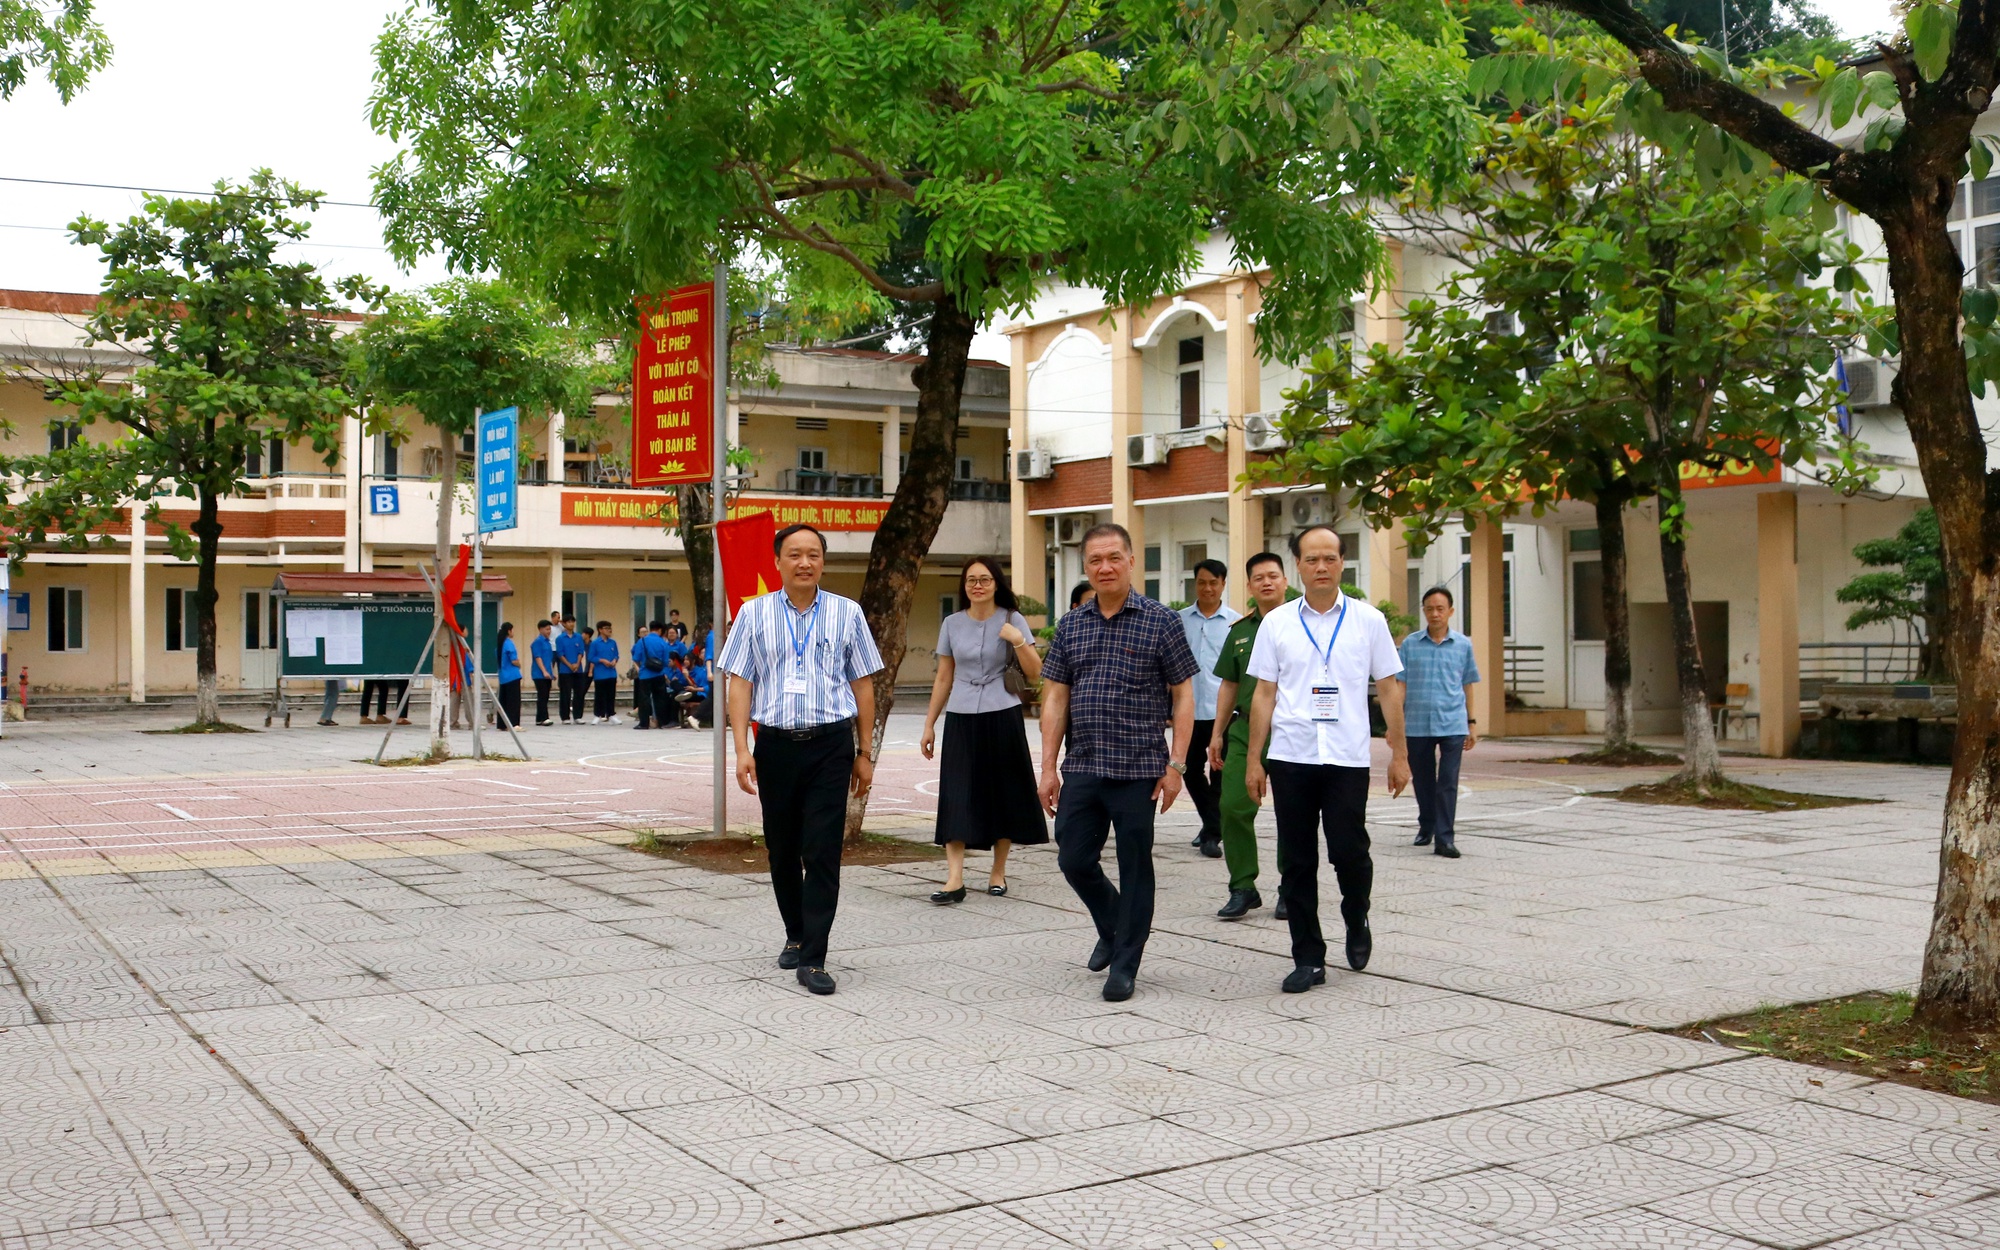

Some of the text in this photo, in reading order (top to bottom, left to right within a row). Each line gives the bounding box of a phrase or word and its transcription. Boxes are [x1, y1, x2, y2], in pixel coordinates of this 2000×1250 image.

[672, 308, 699, 328] TRỌNG
[657, 333, 691, 354] LỄ PHÉP
[649, 356, 699, 380] VỚI THẦY CÔ
[653, 381, 694, 405] ĐOÀN KẾT
[656, 409, 690, 429] THÂN ÁI
[650, 434, 697, 456] VỚI BẠN BÈ
[376, 493, 395, 513] B
[574, 496, 592, 517] MỖI
[595, 497, 617, 518] THẦY
[782, 507, 799, 526] ĐẠO
[801, 505, 821, 524] ĐỨC,
[822, 506, 834, 526] TỰ
[835, 508, 854, 526] HỌC,
[855, 506, 878, 525] SÁNG
[381, 605, 413, 613] THÔNG
[415, 604, 434, 613] BÁO
